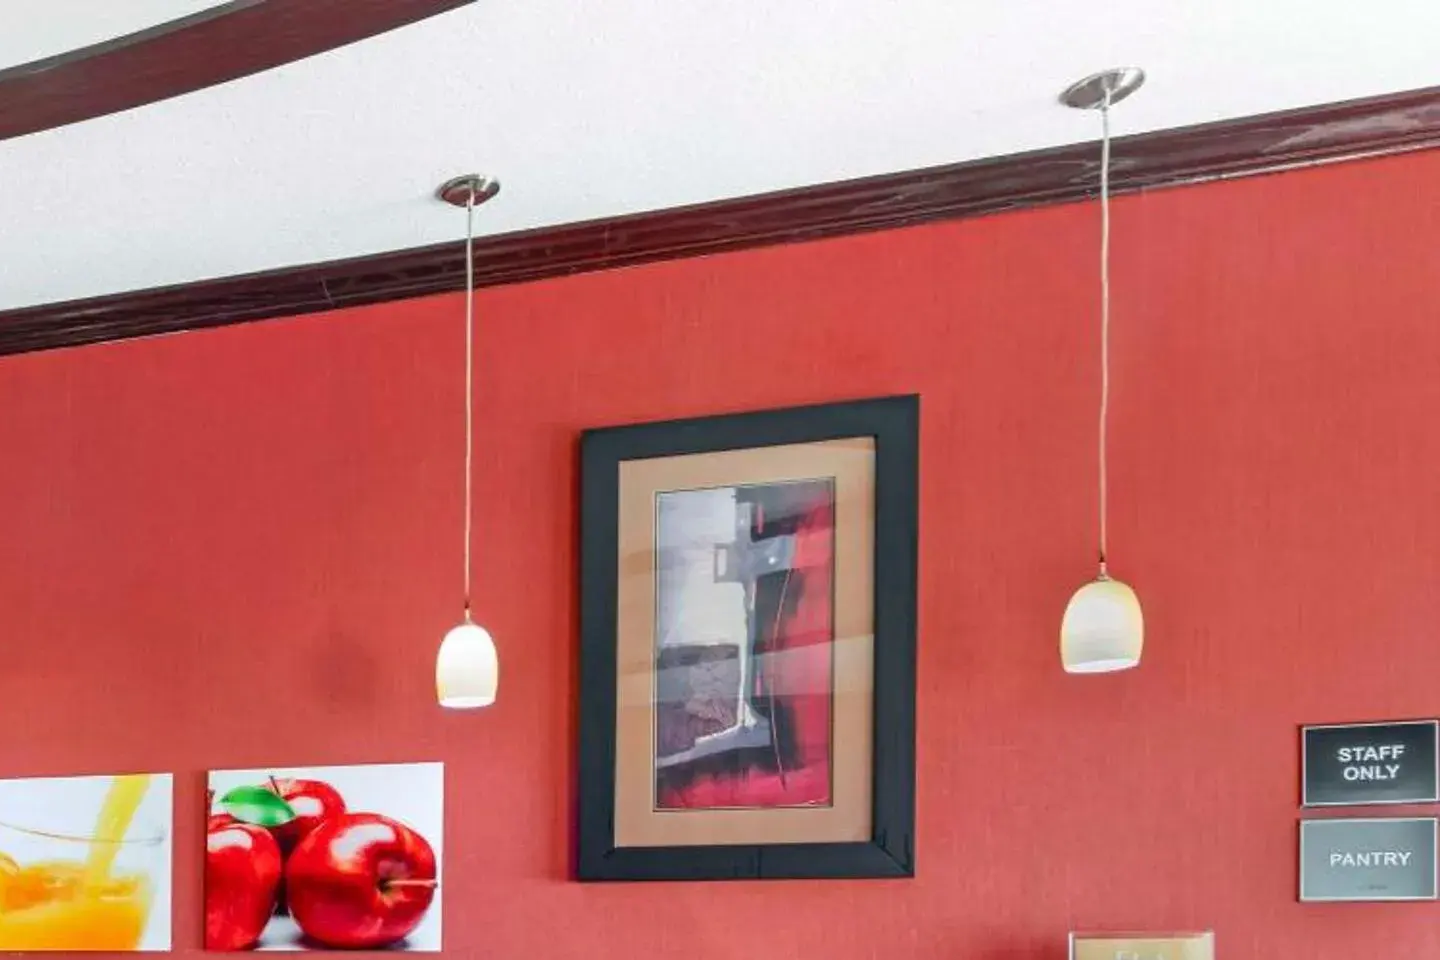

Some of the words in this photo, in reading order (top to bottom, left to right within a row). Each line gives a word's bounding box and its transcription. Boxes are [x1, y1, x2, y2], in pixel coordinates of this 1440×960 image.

[1337, 744, 1405, 762] STAFF
[1343, 764, 1400, 781] ONLY
[1329, 851, 1412, 867] PANTRY
